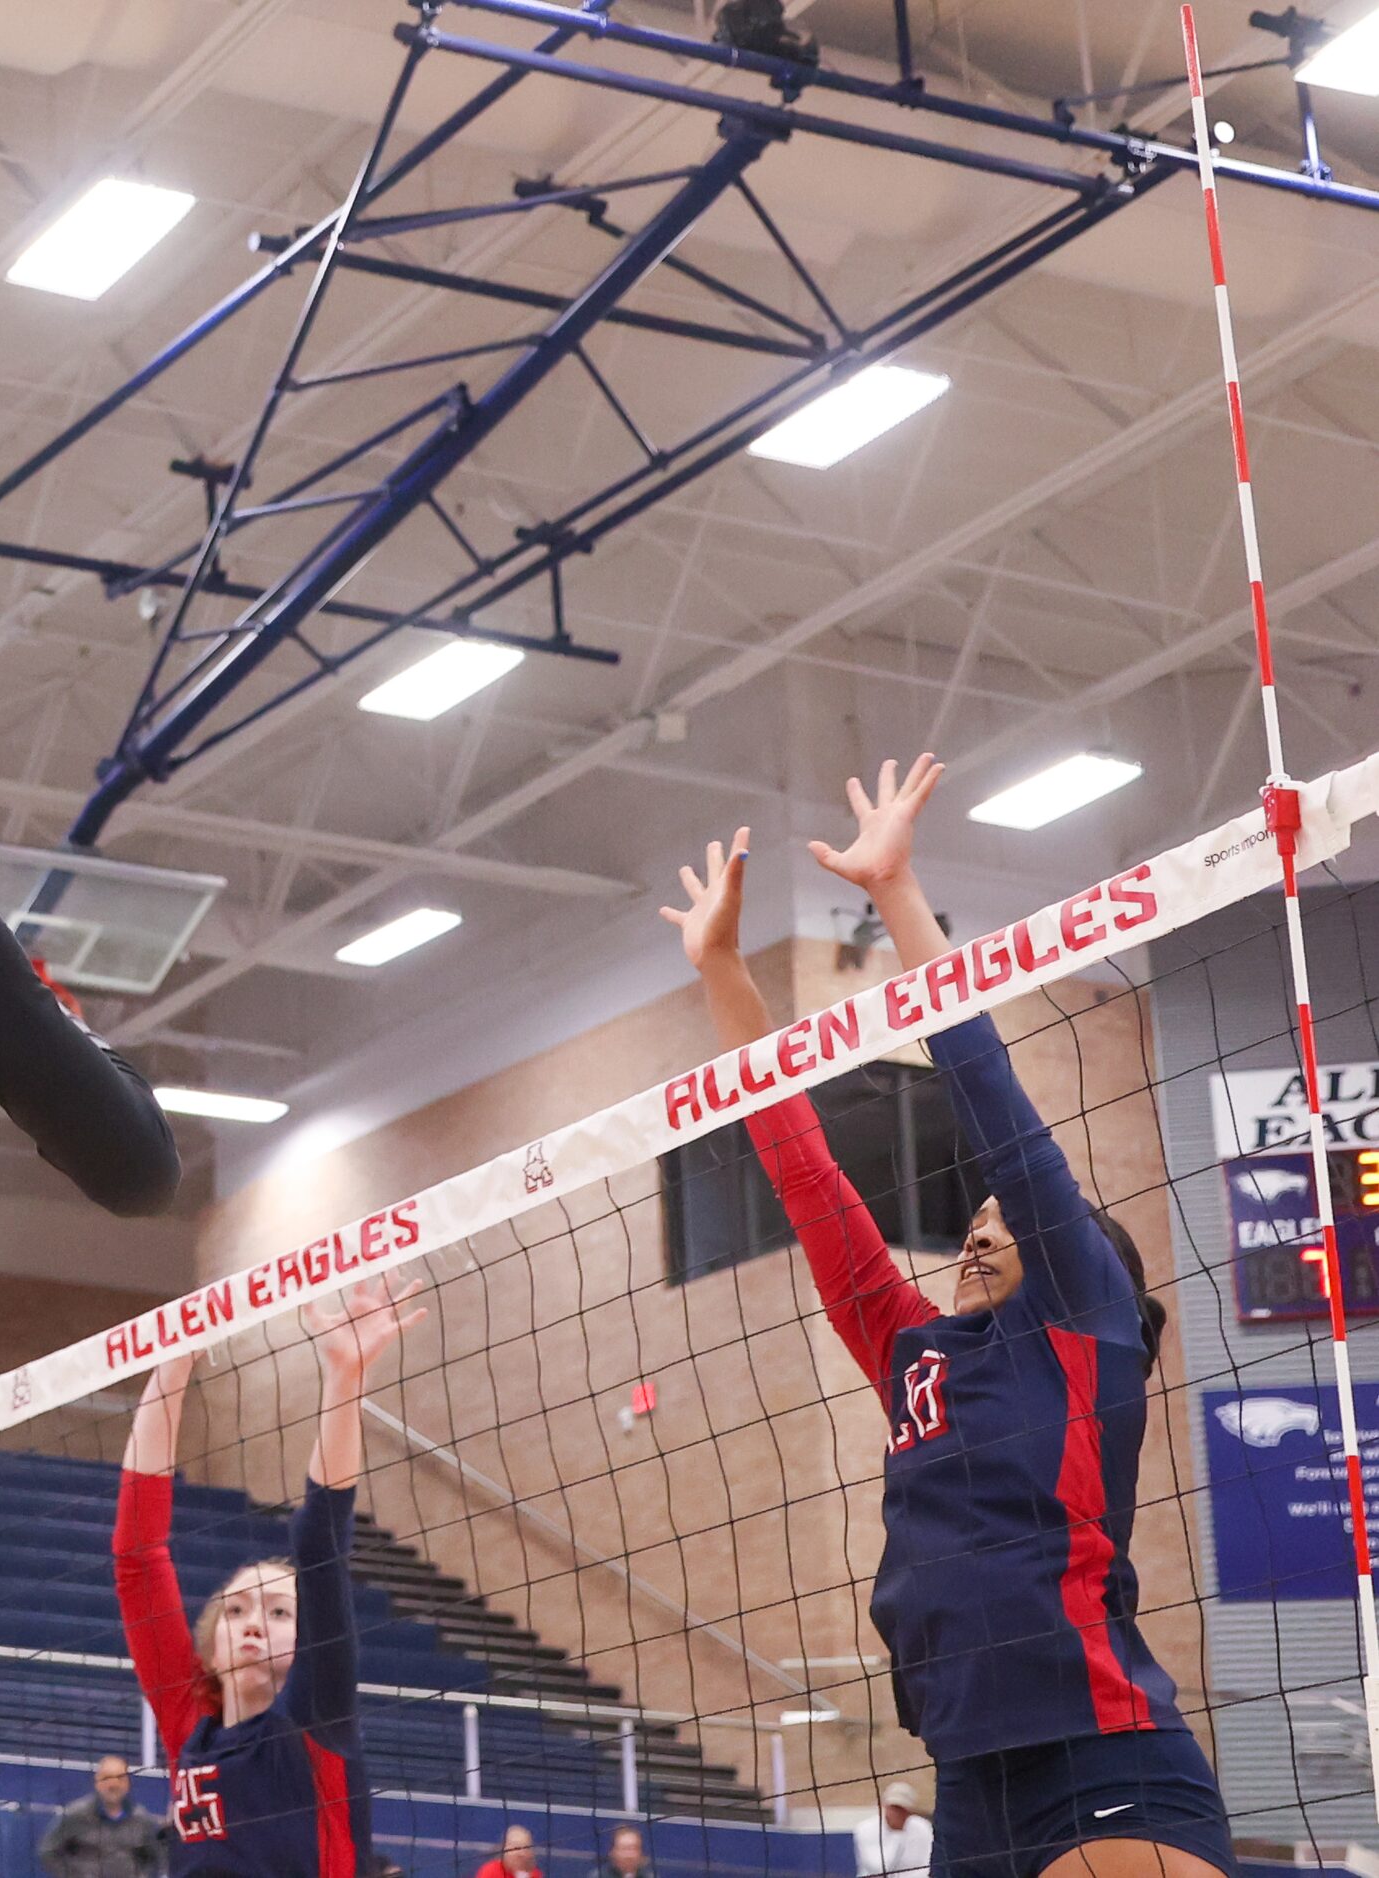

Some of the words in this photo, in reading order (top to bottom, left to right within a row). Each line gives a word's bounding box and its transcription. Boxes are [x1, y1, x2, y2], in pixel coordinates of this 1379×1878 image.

[1204, 844, 1240, 868] sports
[664, 998, 862, 1131] ALLEN
[884, 863, 1158, 1030] EAGLES
[1270, 1070, 1379, 1107] AL
[104, 1275, 234, 1369] ALLEN
[247, 1198, 420, 1309] EAGLES
[173, 1764, 226, 1841] 25
